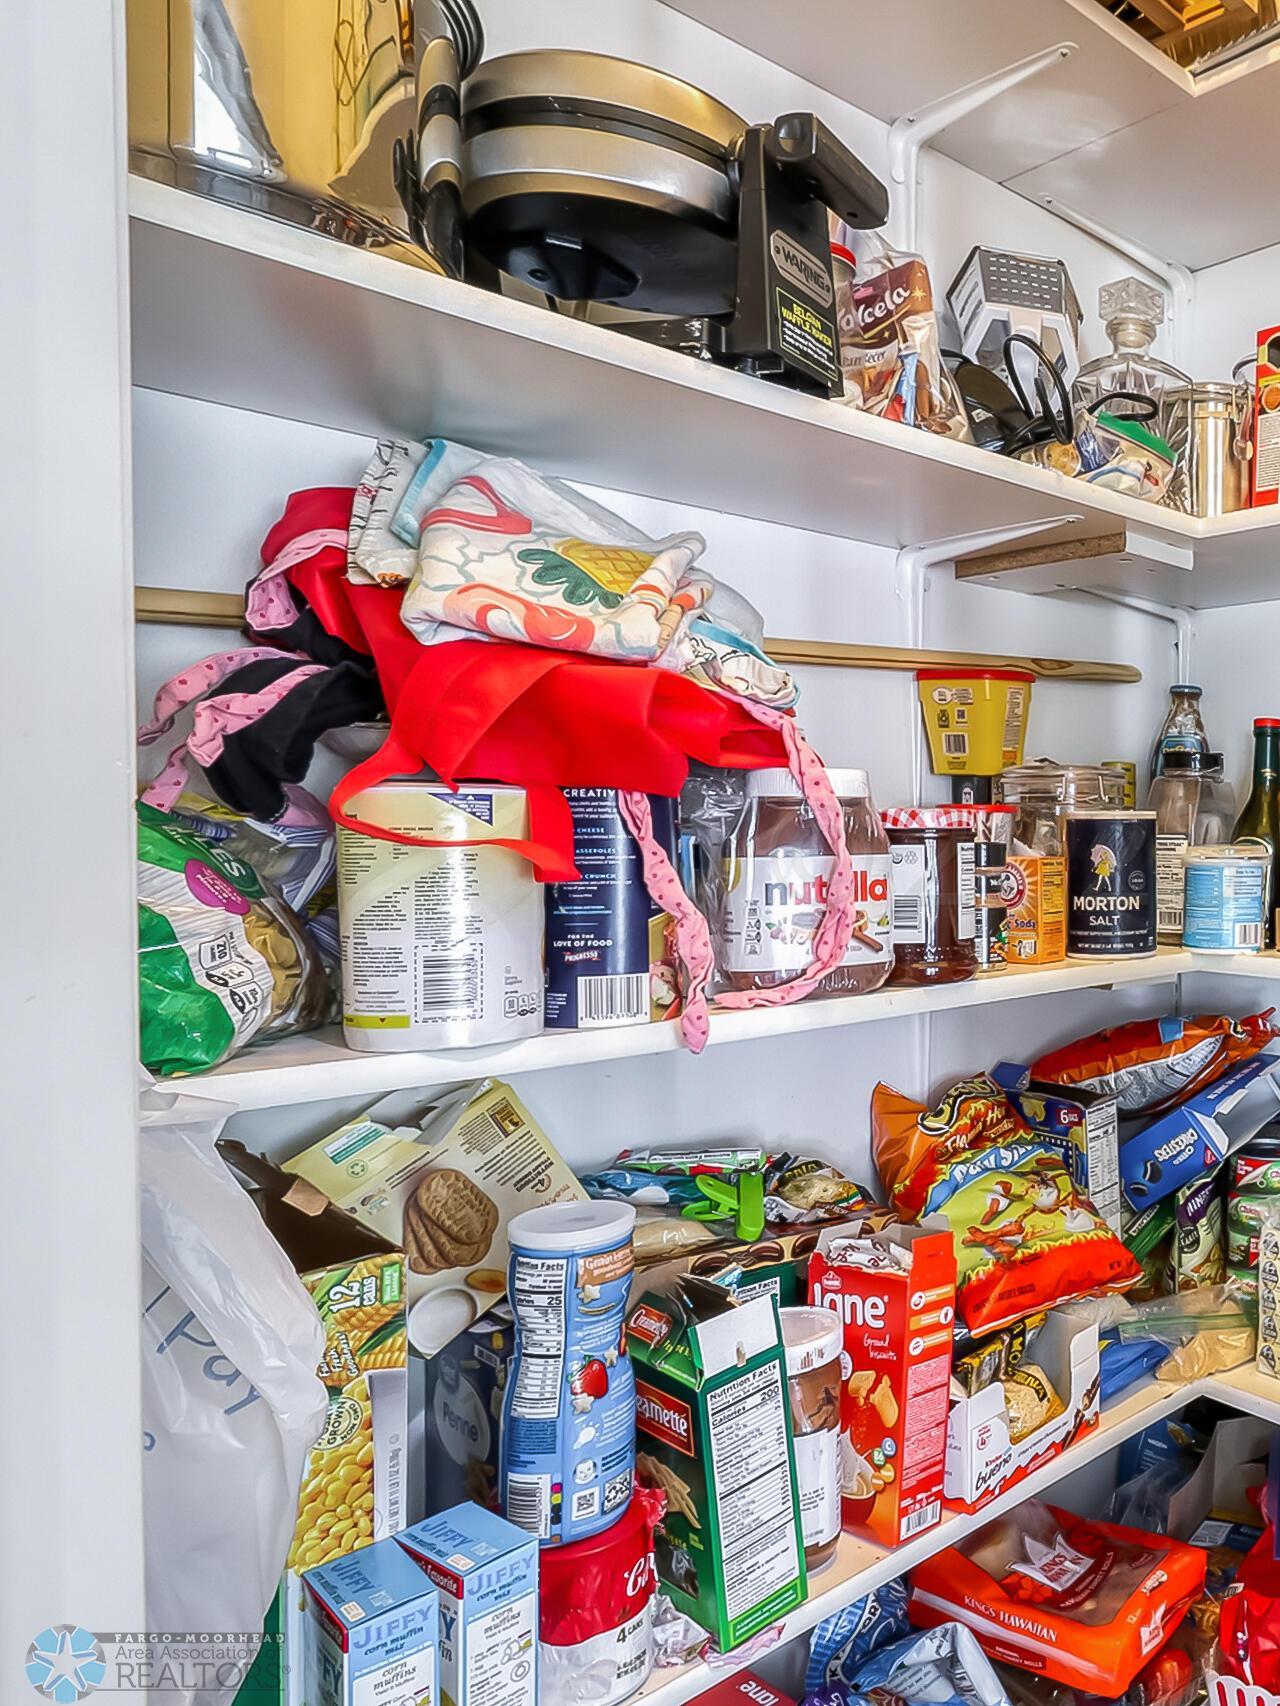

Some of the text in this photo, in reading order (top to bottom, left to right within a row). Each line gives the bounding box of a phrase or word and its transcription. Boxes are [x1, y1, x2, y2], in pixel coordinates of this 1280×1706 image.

[782, 246, 825, 290] WARING
[781, 306, 811, 333] WAFFLE
[811, 325, 833, 347] MAKER
[792, 303, 822, 330] BELGIAN
[563, 789, 615, 797] CREATIV
[764, 871, 887, 906] nutlla
[1073, 896, 1140, 911] MORTON
[1015, 919, 1036, 928] Soda
[1089, 915, 1120, 926] SALT
[1060, 1110, 1069, 1124] 6
[1155, 1127, 1198, 1164] CAKESTERS
[1171, 1146, 1195, 1167] OREO
[540, 1262, 564, 1271] Facts
[329, 1280, 362, 1314] 12
[362, 1275, 378, 1307] cans
[547, 1296, 562, 1306] 25
[864, 1333, 890, 1347] Ground
[709, 1362, 778, 1402] Nutrition Facts
[760, 1385, 780, 1402] 200
[327, 1399, 348, 1446] GROWN
[443, 1402, 479, 1443] Penne
[636, 1394, 688, 1437] eamette
[711, 1405, 747, 1427] Calories
[975, 1451, 1013, 1491] bueno
[420, 1520, 474, 1549] JIFFY
[330, 1560, 375, 1595] JIFFY
[426, 1563, 458, 1593] favorite
[466, 1552, 536, 1597] JIFFY
[499, 1573, 528, 1591] muffin
[353, 1602, 435, 1649] JIFFY
[491, 1606, 514, 1623] corn
[964, 1595, 1058, 1642] KINGS HAWAIIAN
[364, 1625, 424, 1656] corn muffin
[616, 1626, 627, 1644] 4
[373, 1666, 417, 1691] muffins
[381, 1661, 408, 1678] corn
